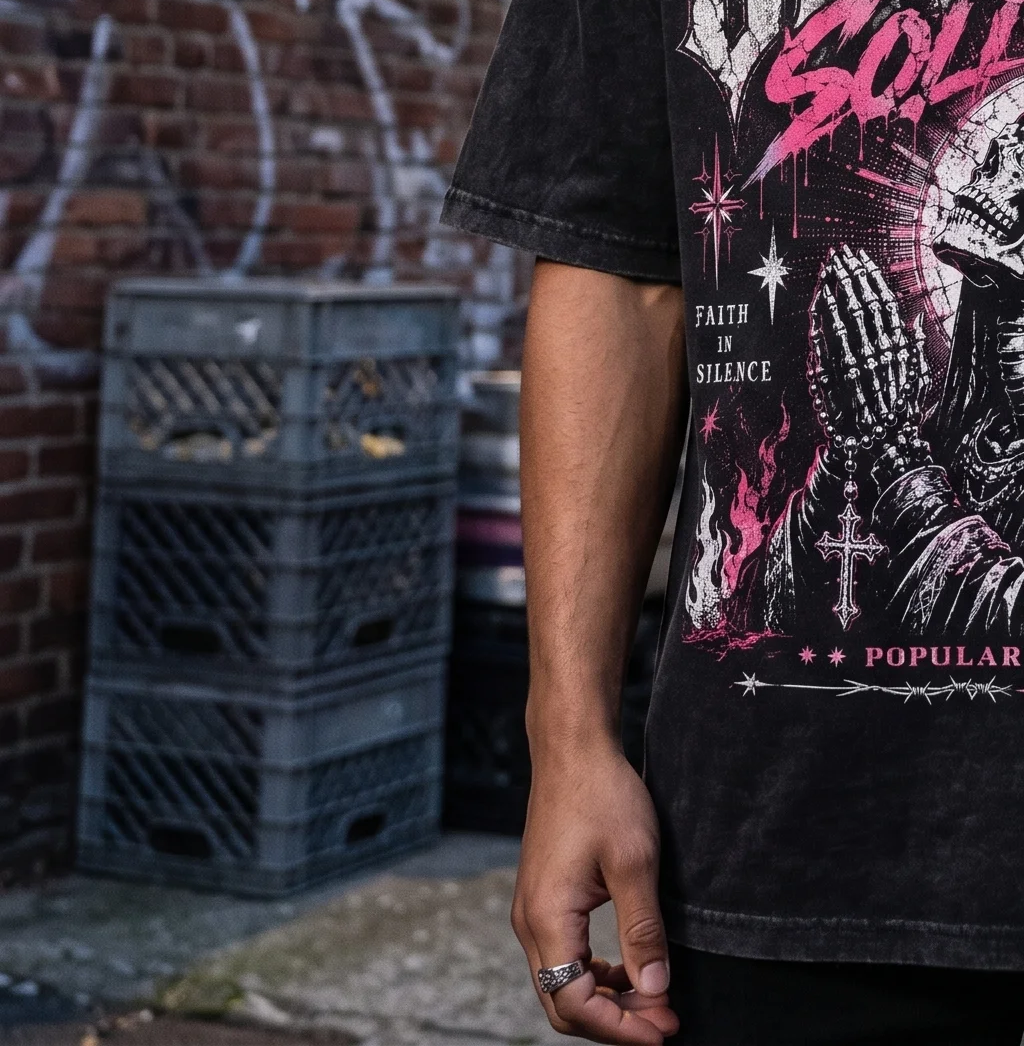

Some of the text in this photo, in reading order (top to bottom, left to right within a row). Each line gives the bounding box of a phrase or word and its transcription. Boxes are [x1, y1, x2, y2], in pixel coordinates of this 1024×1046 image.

[695, 303, 749, 328] FAITH
[717, 335, 733, 353] IN
[696, 360, 772, 384] SILENCE
[864, 646, 1021, 667] POPULAR
